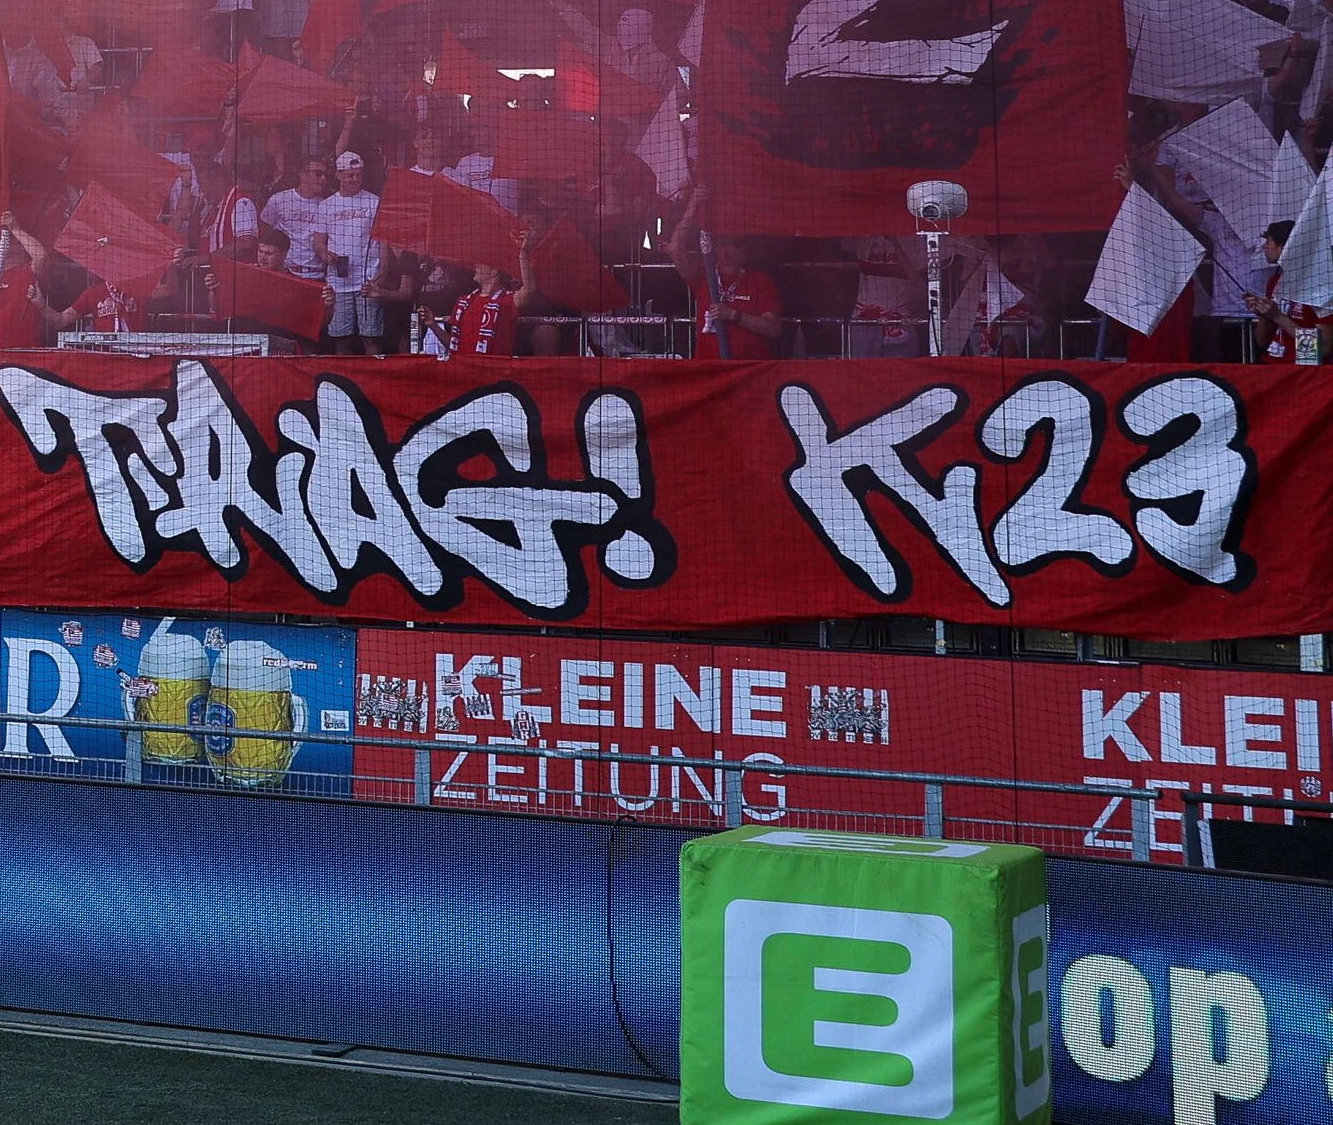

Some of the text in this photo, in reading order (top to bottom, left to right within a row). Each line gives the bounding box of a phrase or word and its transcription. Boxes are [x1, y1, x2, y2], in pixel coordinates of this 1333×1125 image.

[774, 369, 1257, 609] K23
[435, 652, 788, 739] KLEINE
[1081, 688, 1333, 773] KLEI
[434, 732, 787, 822] ZEITUNG
